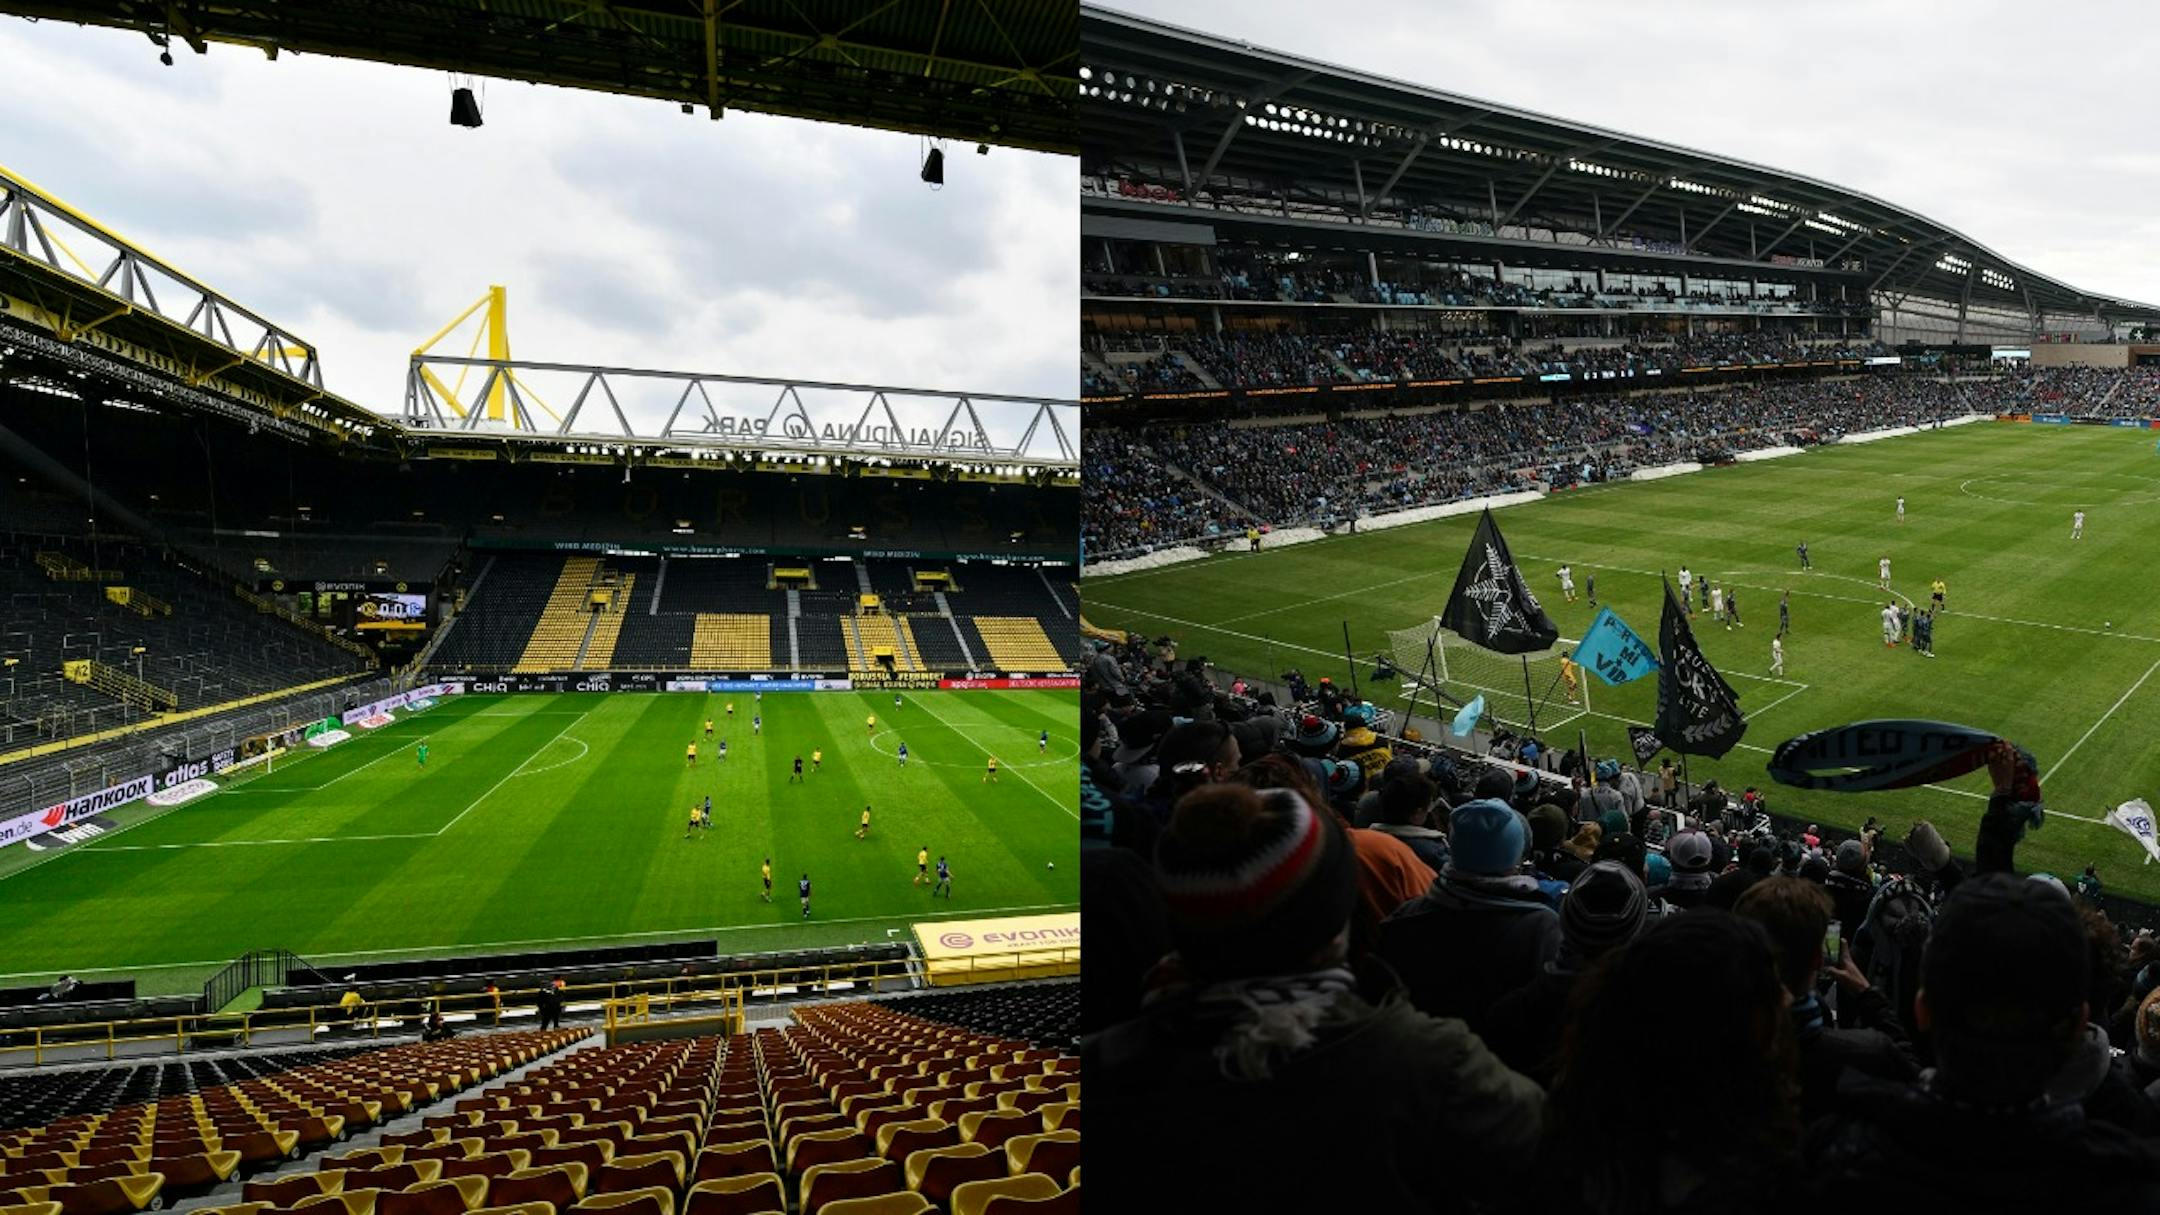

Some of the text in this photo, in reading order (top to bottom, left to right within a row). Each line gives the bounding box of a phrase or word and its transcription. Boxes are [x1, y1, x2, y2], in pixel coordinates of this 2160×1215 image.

[848, 672, 891, 681] BORUSSIA
[165, 760, 209, 787] atlas
[65, 779, 147, 821] HANKOOK
[983, 926, 1081, 943] EVONIK
